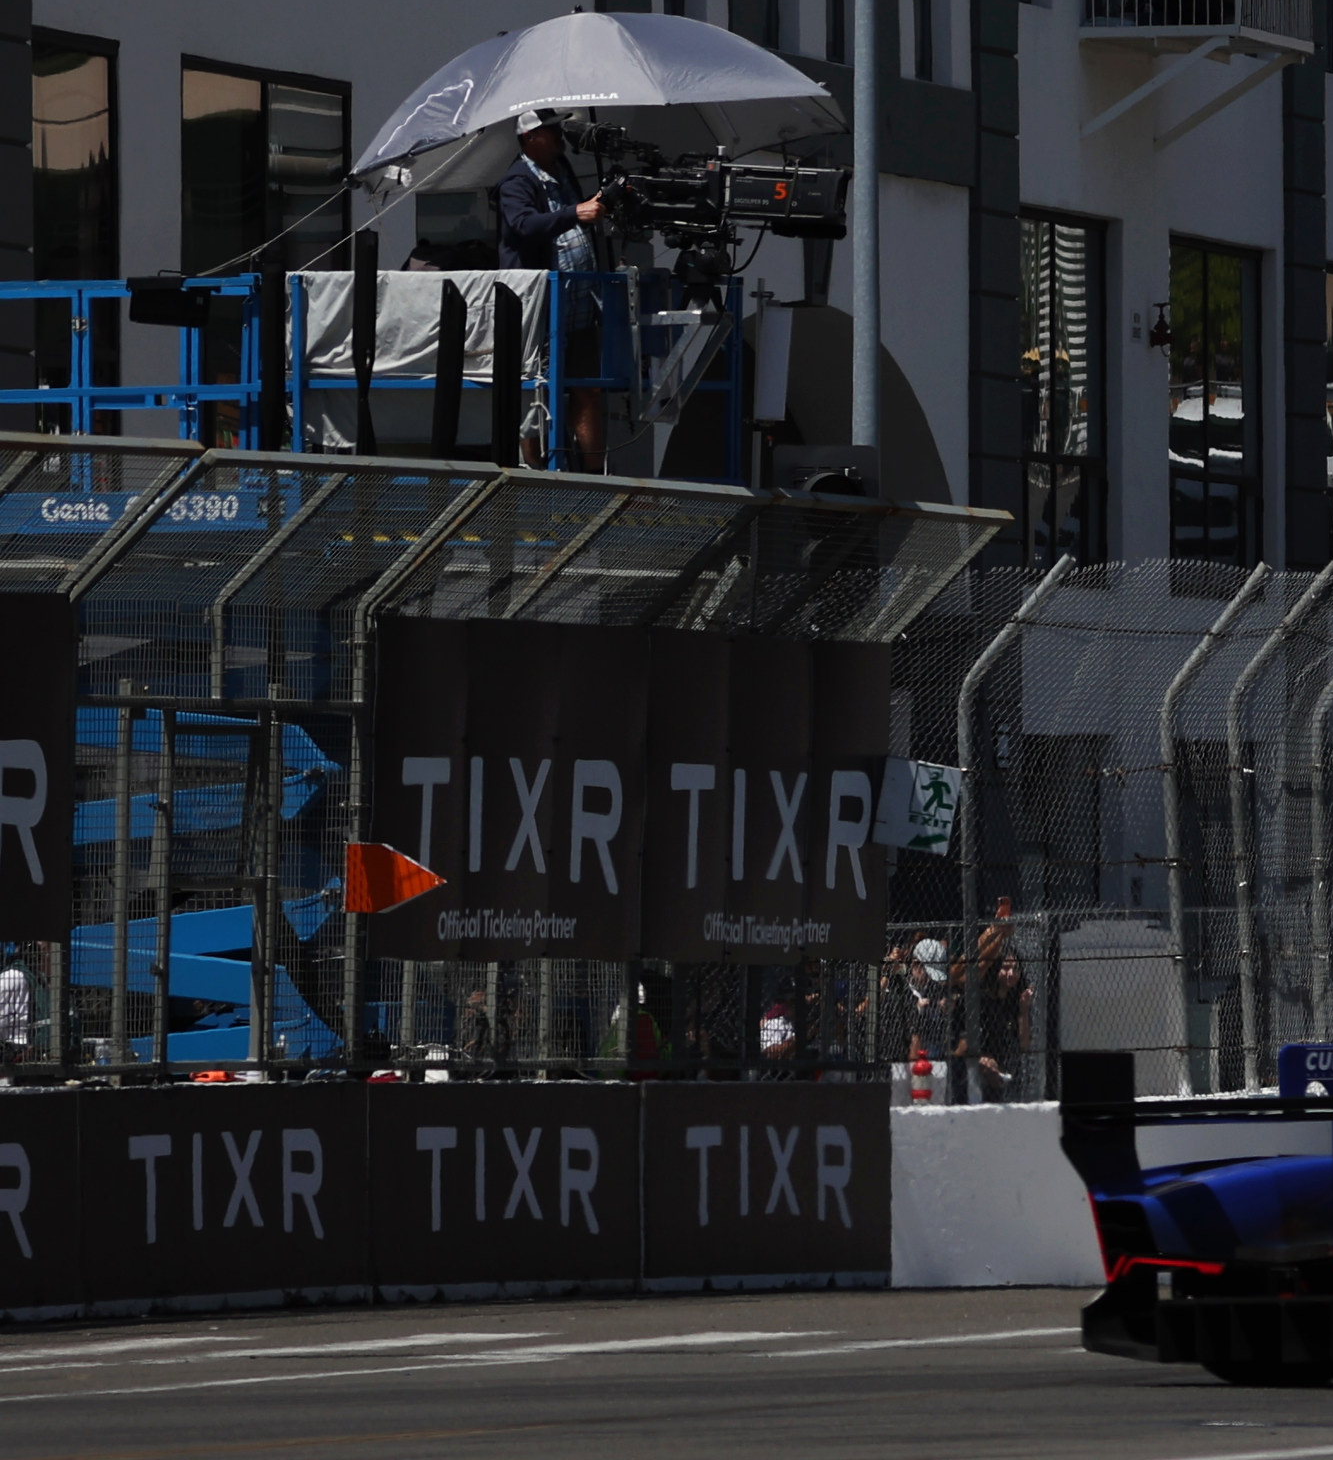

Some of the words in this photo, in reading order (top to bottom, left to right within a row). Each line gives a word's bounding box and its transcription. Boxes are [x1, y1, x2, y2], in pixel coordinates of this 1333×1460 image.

[773, 181, 789, 200] 5
[41, 496, 111, 522] Genie
[402, 756, 623, 895] TIXR
[670, 763, 873, 901] TIXR
[908, 814, 952, 829] EXIT
[438, 908, 480, 942] Official
[482, 908, 533, 946] Ticketing
[533, 910, 577, 941] Partner
[703, 911, 744, 945] Official
[745, 915, 790, 953] Ticketing
[790, 917, 831, 947] Partner
[129, 1127, 325, 1244] TIXR
[416, 1126, 600, 1234] TIXR
[685, 1124, 854, 1229] TIXR
